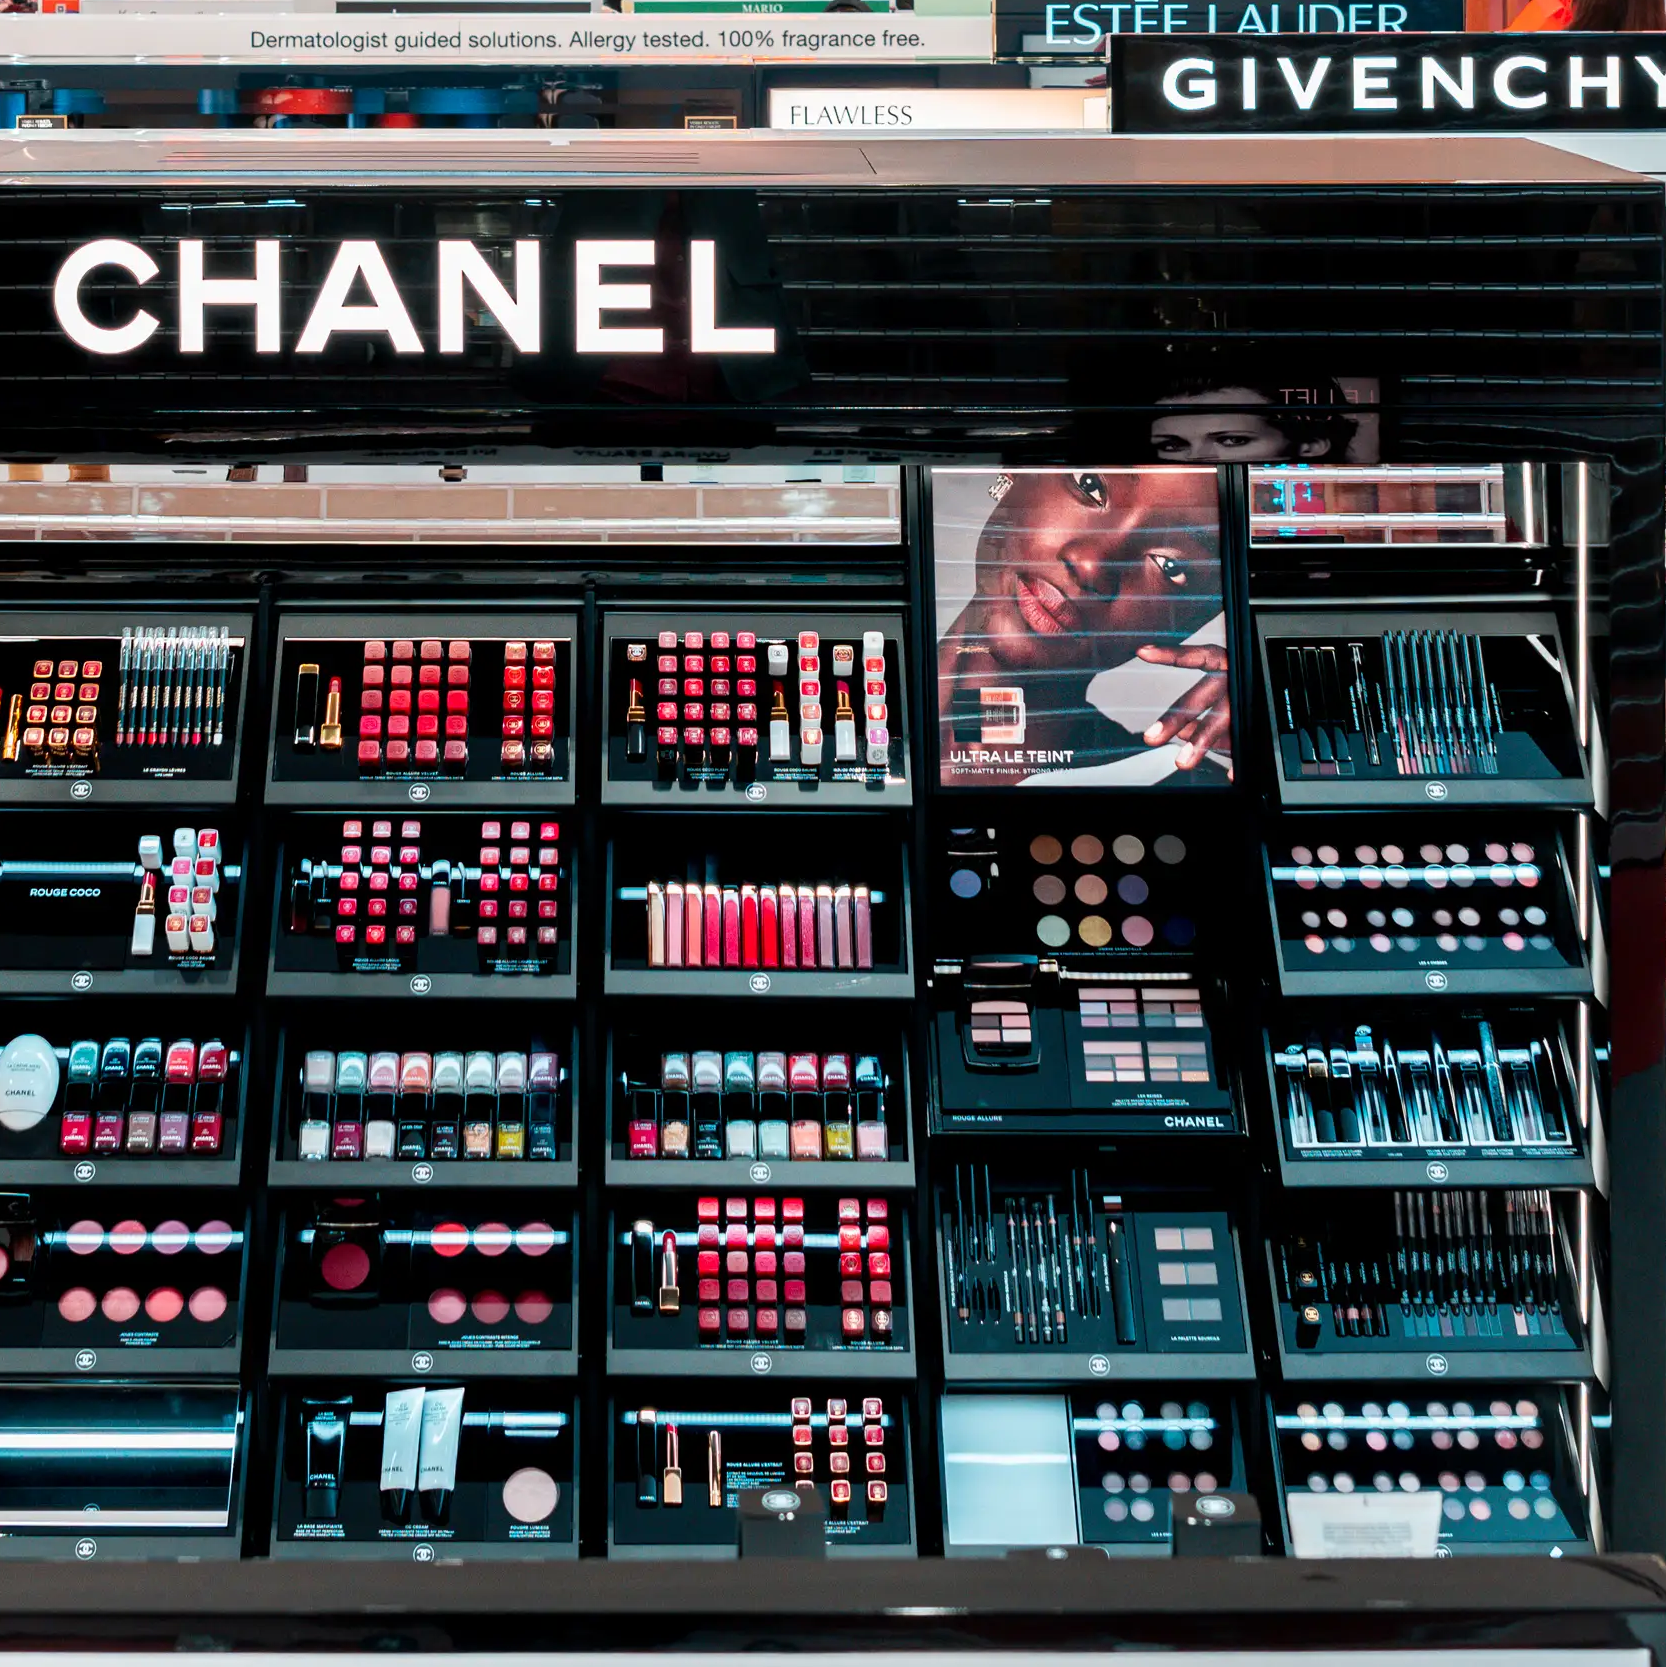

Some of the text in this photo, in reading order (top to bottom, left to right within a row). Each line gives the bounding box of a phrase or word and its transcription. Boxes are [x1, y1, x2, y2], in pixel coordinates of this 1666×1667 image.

[742, 3, 783, 14] MARIO
[250, 29, 926, 53] Dermatologist guided solutions. Allergy tested. 100% fragrance free.
[790, 104, 913, 126] FLAWLESS
[53, 238, 776, 357] CHANEL
[950, 750, 1074, 763] ULTRA LE TEINT
[951, 767, 995, 775] SOFT-MATTE
[30, 888, 101, 897] ROUGE COCO
[5, 1089, 36, 1097] CHANEL
[1164, 1116, 1225, 1128] CHANEL
[420, 1465, 444, 1473] CHANEL
[310, 1473, 336, 1481] CHANEL
